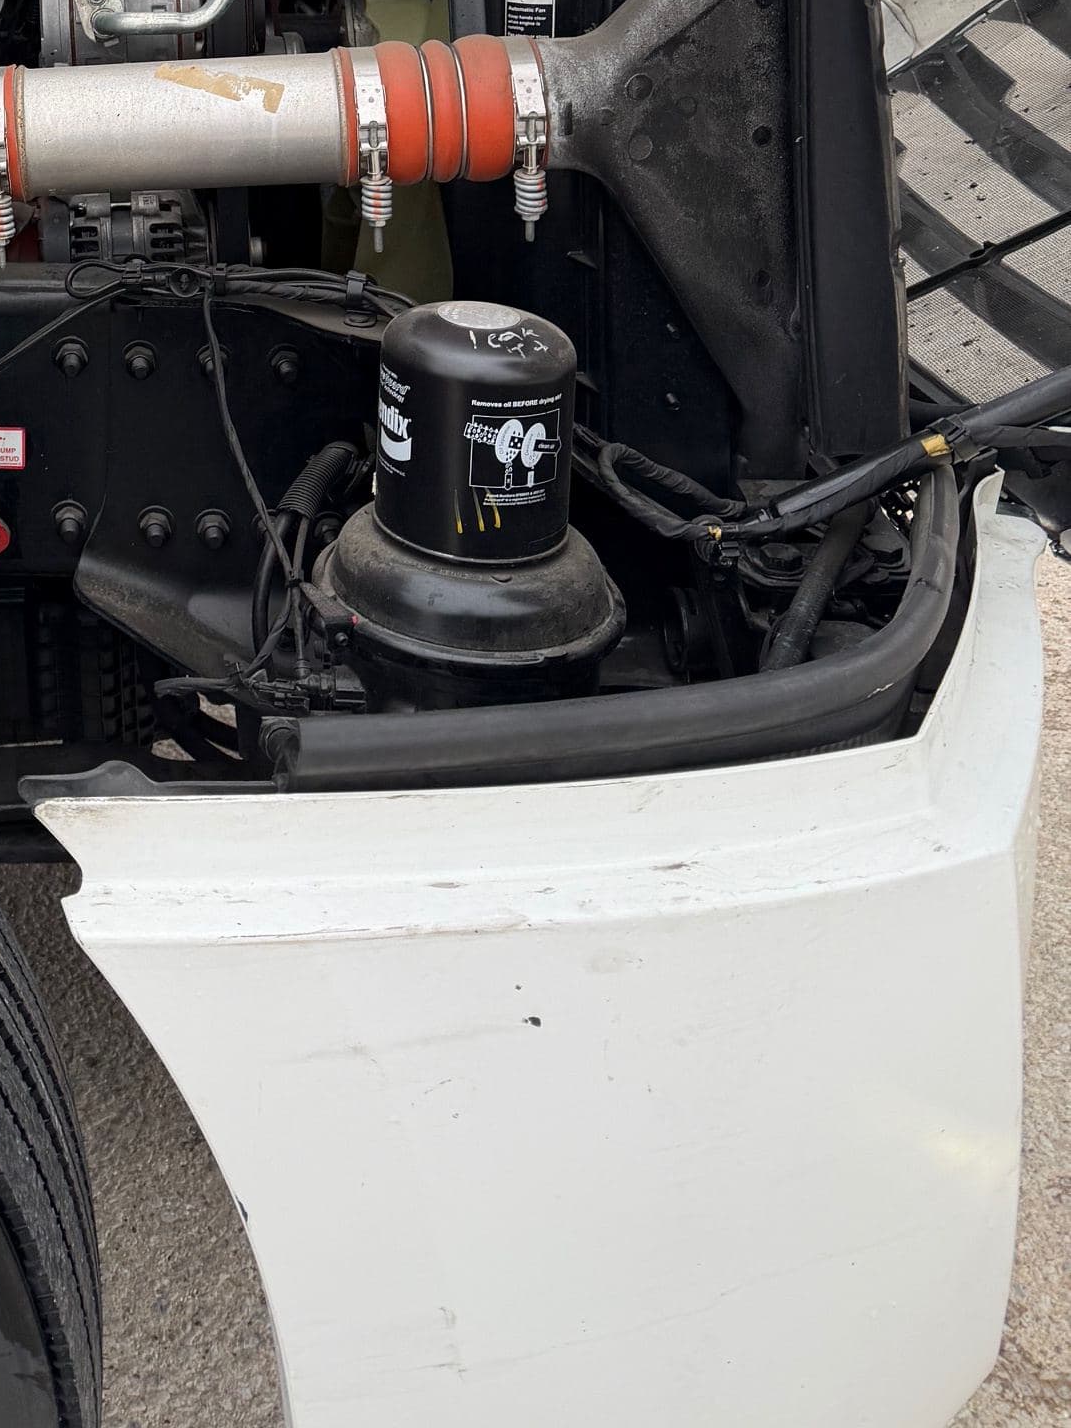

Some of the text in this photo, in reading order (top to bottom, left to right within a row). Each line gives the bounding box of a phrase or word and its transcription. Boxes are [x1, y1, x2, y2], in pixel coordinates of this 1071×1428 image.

[472, 399, 502, 408] Removes
[512, 399, 538, 408] BEFORE
[539, 397, 554, 405] drying
